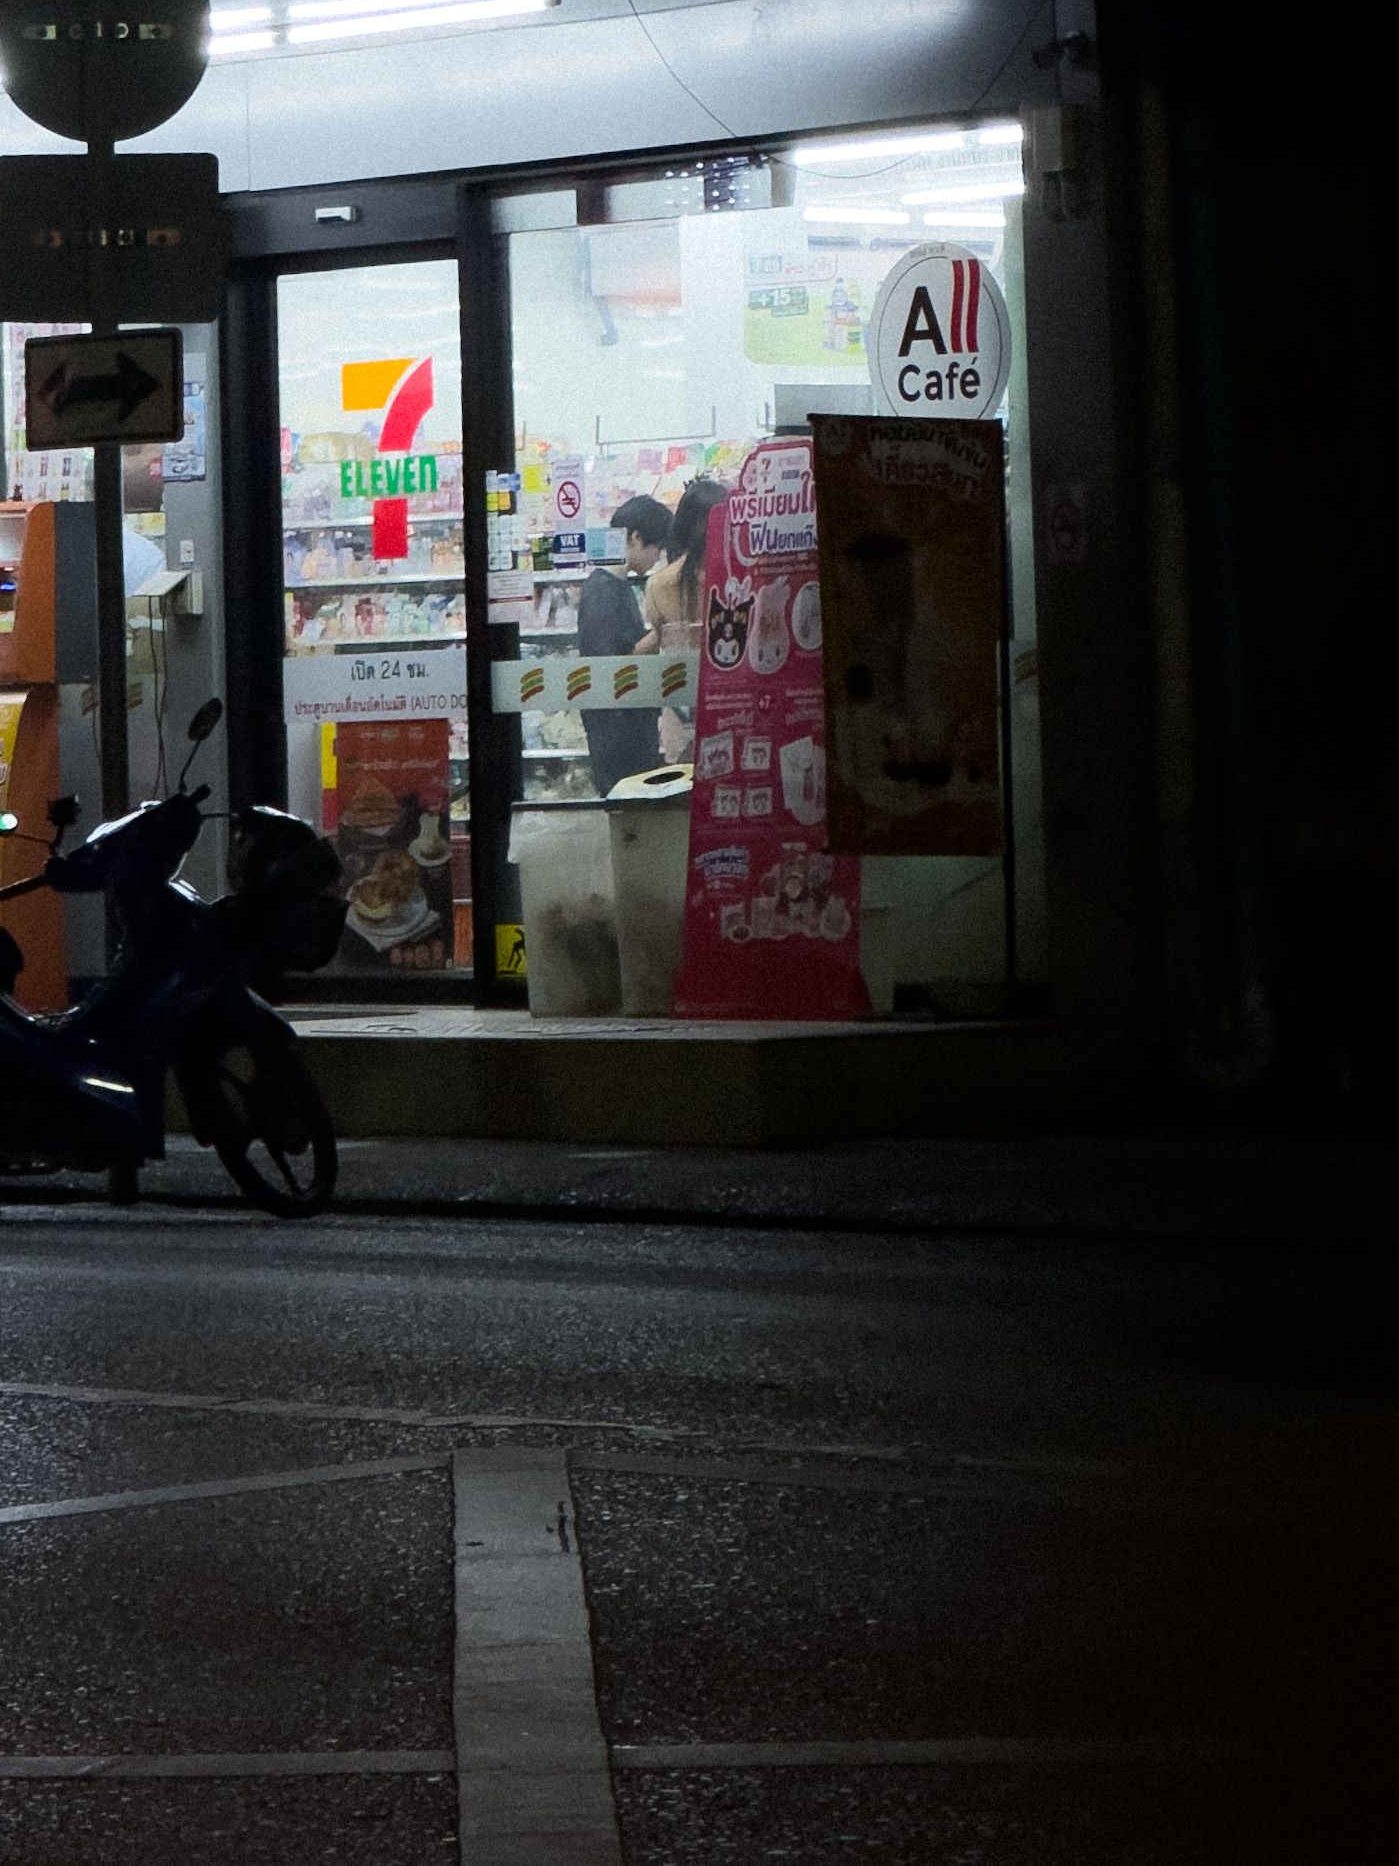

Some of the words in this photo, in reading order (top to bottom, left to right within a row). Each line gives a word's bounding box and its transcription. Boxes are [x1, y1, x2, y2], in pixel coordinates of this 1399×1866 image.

[898, 258, 980, 357] All
[898, 356, 980, 402] Café
[342, 356, 434, 559] 7
[560, 535, 580, 547] VAT
[351, 660, 375, 681] เปิด
[381, 660, 400, 680] 24
[411, 694, 446, 712] (AUTO
